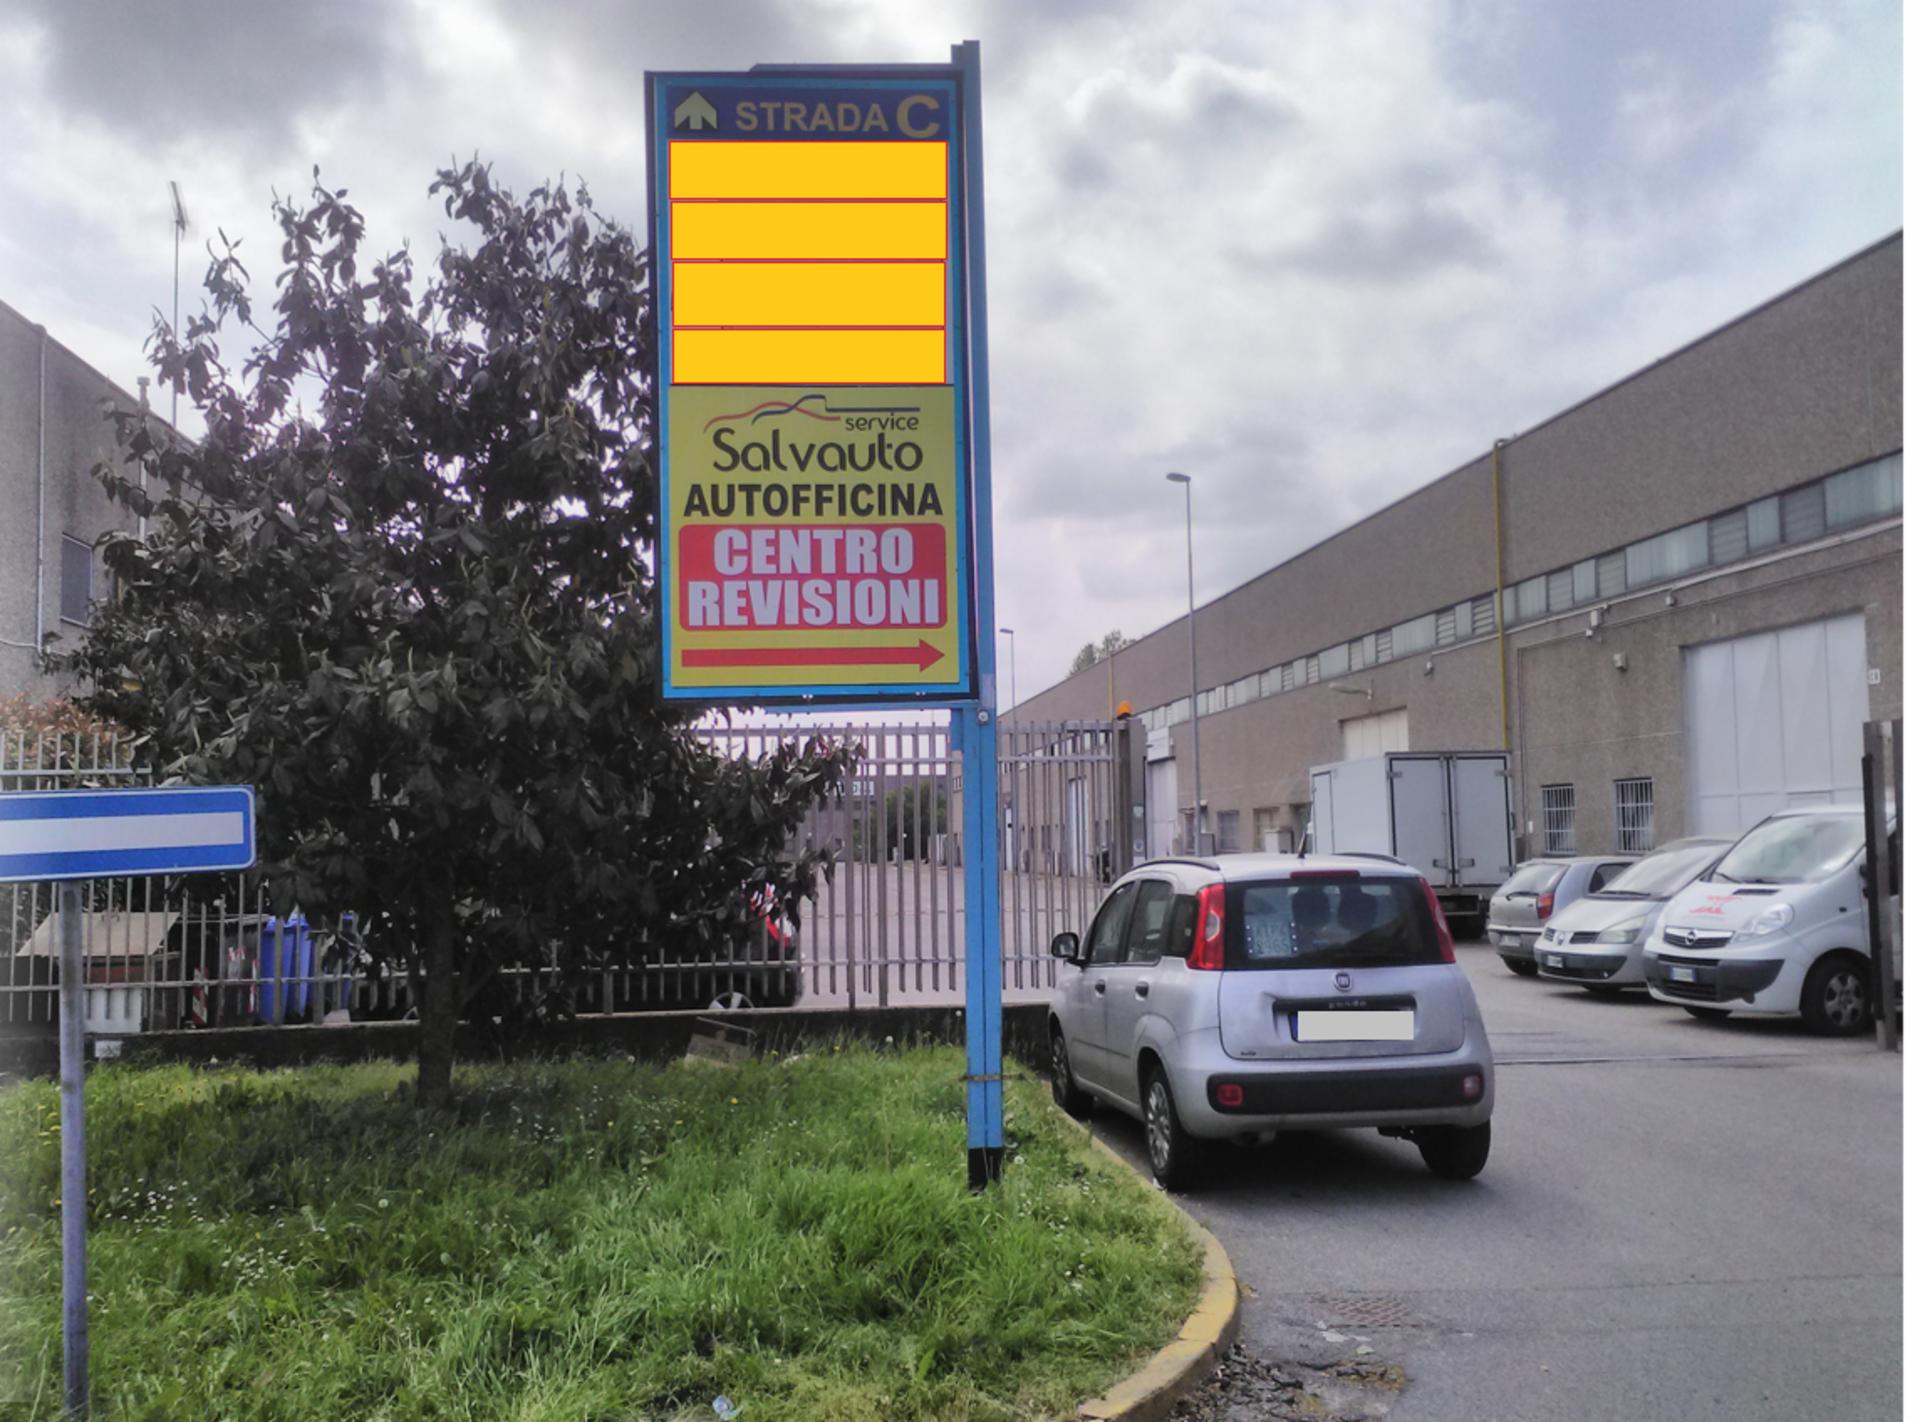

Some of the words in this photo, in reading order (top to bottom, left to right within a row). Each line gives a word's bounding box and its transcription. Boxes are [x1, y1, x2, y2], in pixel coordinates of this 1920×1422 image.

[735, 102, 889, 132] STRADA
[896, 94, 940, 138] C
[845, 412, 919, 431] service
[712, 427, 923, 472] Salvauto
[683, 483, 943, 517] AUTOFFICINA
[713, 528, 914, 576] CENTRO
[688, 578, 940, 626] REVISIONI
